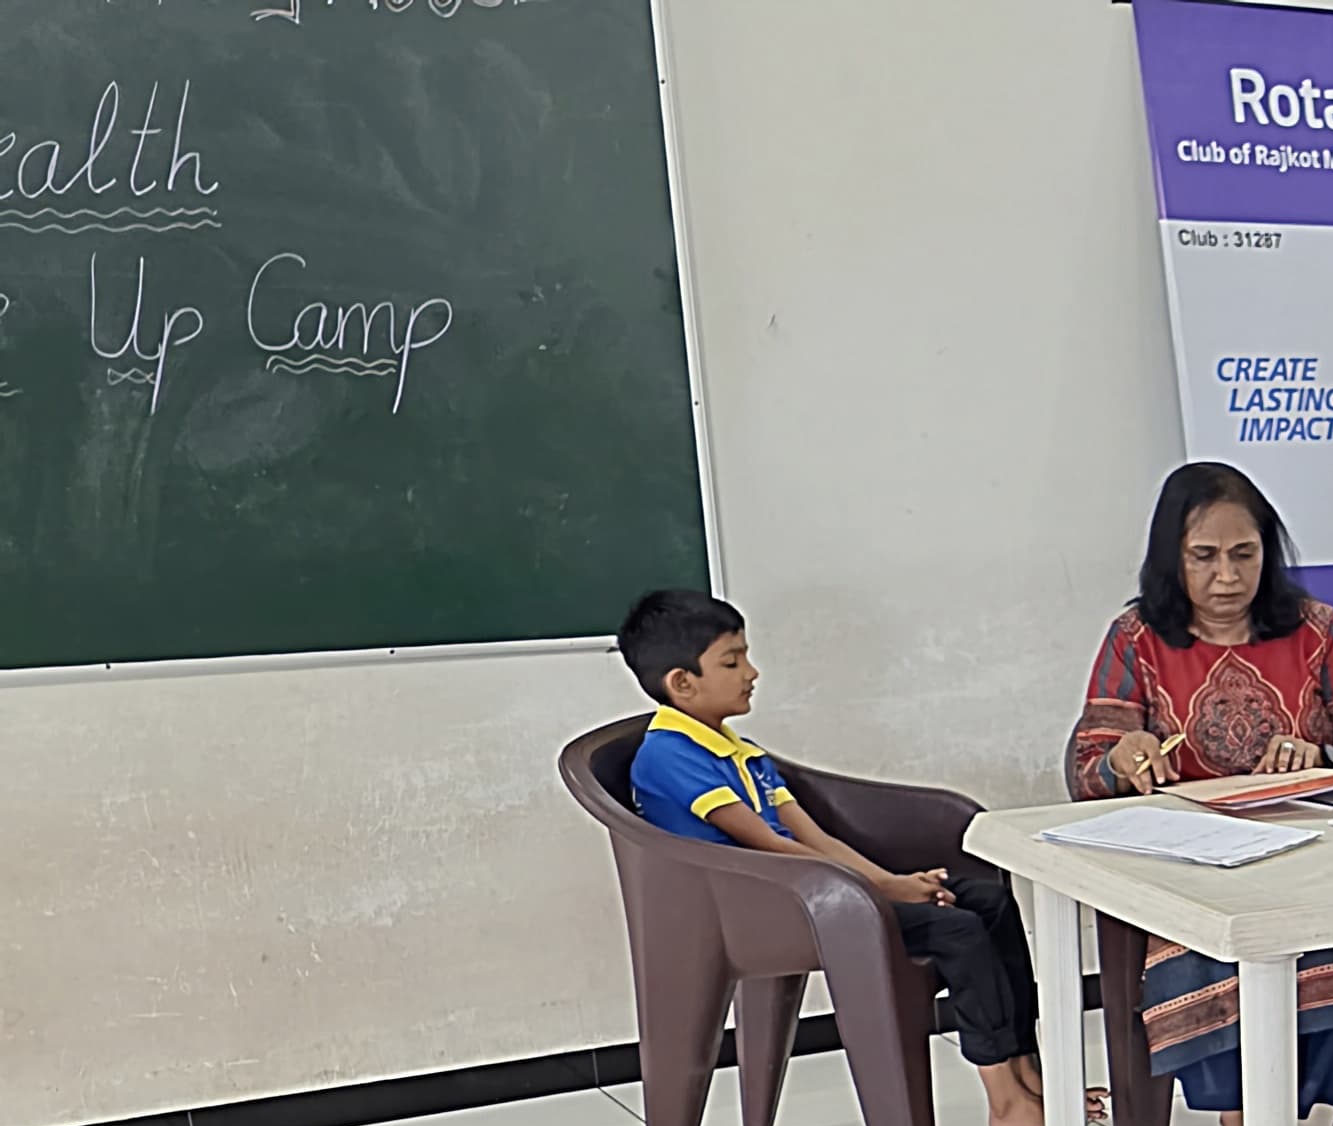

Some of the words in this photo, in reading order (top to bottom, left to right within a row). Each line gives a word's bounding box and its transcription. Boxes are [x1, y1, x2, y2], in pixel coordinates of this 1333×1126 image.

[1177, 140, 1225, 163] Club
[1229, 142, 1251, 164] of
[1255, 145, 1321, 172] Rajkot
[1178, 229, 1218, 247] Club
[1234, 232, 1282, 248] 31287
[90, 252, 202, 415] Up
[247, 253, 452, 414] Camp
[1217, 357, 1318, 381] CREATE
